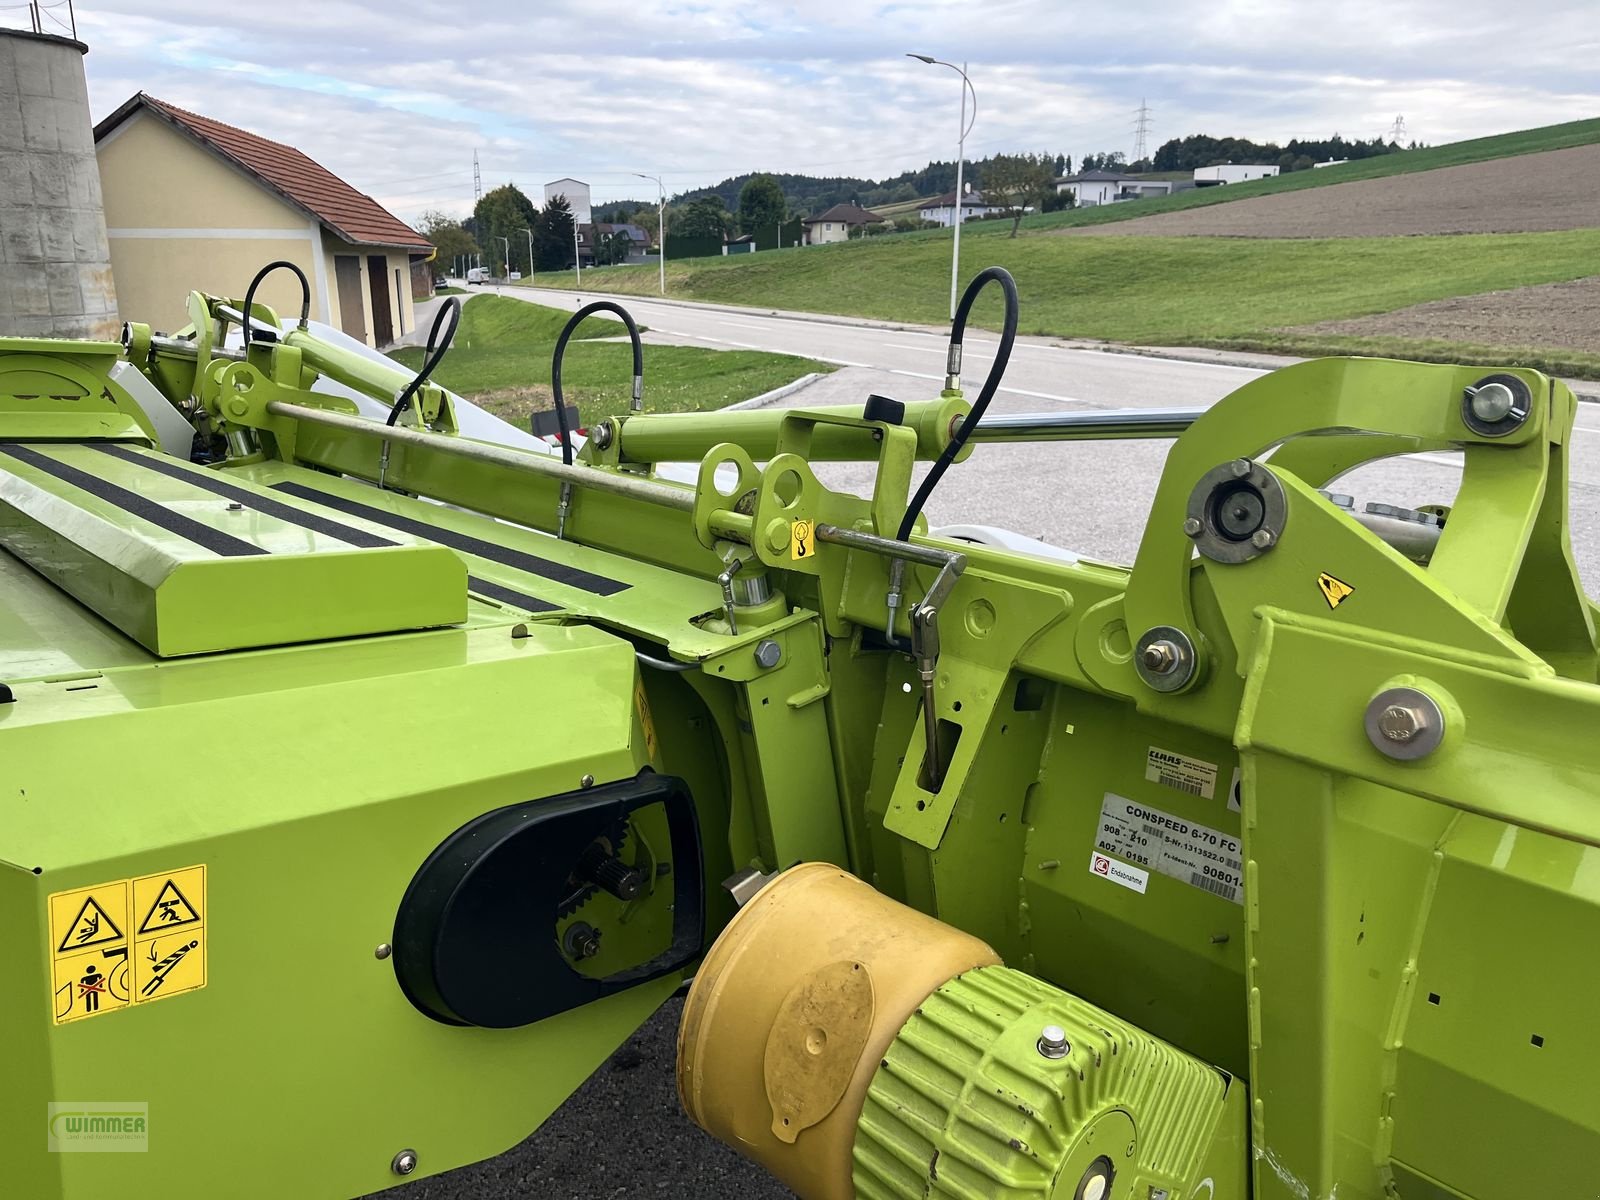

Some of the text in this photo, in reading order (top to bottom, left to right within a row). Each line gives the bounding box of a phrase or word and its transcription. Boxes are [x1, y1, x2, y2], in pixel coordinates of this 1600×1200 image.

[1149, 750, 1182, 765] CLAAS
[1104, 824, 1121, 836] 908
[1130, 834, 1148, 847] 210
[1126, 805, 1188, 834] CONSPEED
[1191, 828, 1217, 845] 6-70
[1219, 840, 1237, 853] FC
[1099, 840, 1117, 853] A02
[1126, 851, 1149, 865] 0195
[1110, 867, 1143, 886] Endabnahme
